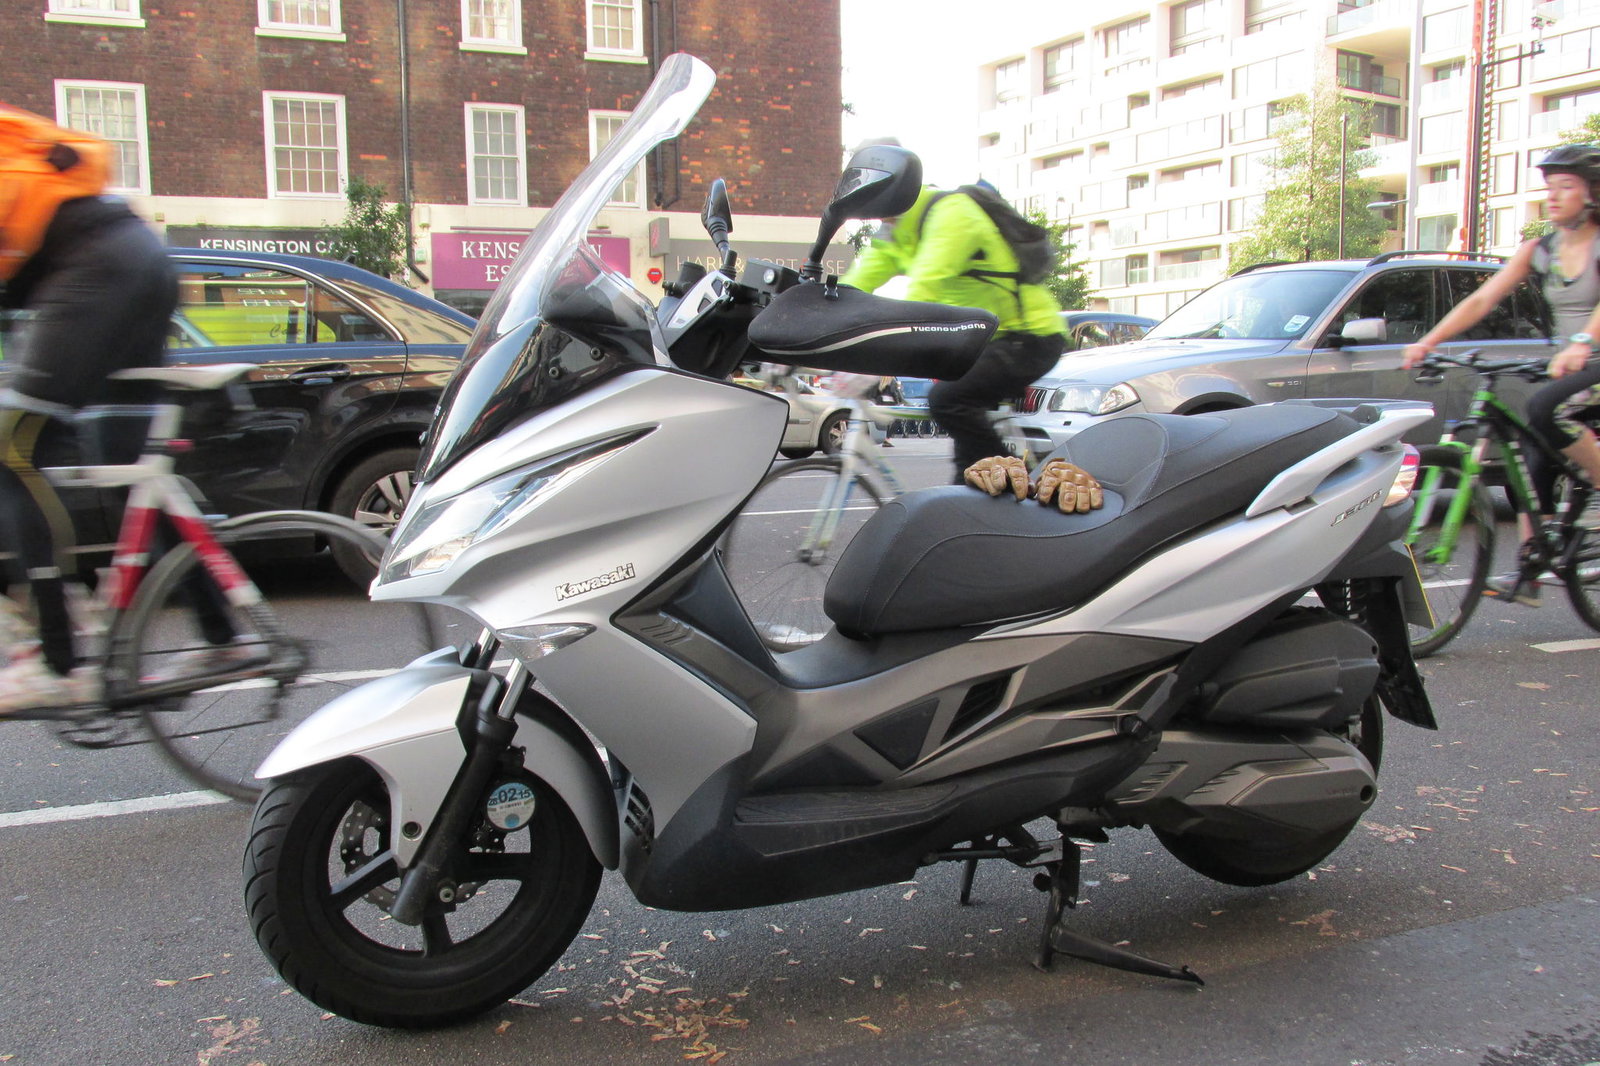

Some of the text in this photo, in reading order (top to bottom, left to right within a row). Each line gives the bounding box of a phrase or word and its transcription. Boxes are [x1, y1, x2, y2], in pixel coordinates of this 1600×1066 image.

[200, 239, 311, 254] KENSINGTON
[555, 563, 636, 601] Kawasaki
[498, 788, 518, 803] 02
[518, 789, 531, 799] 15
